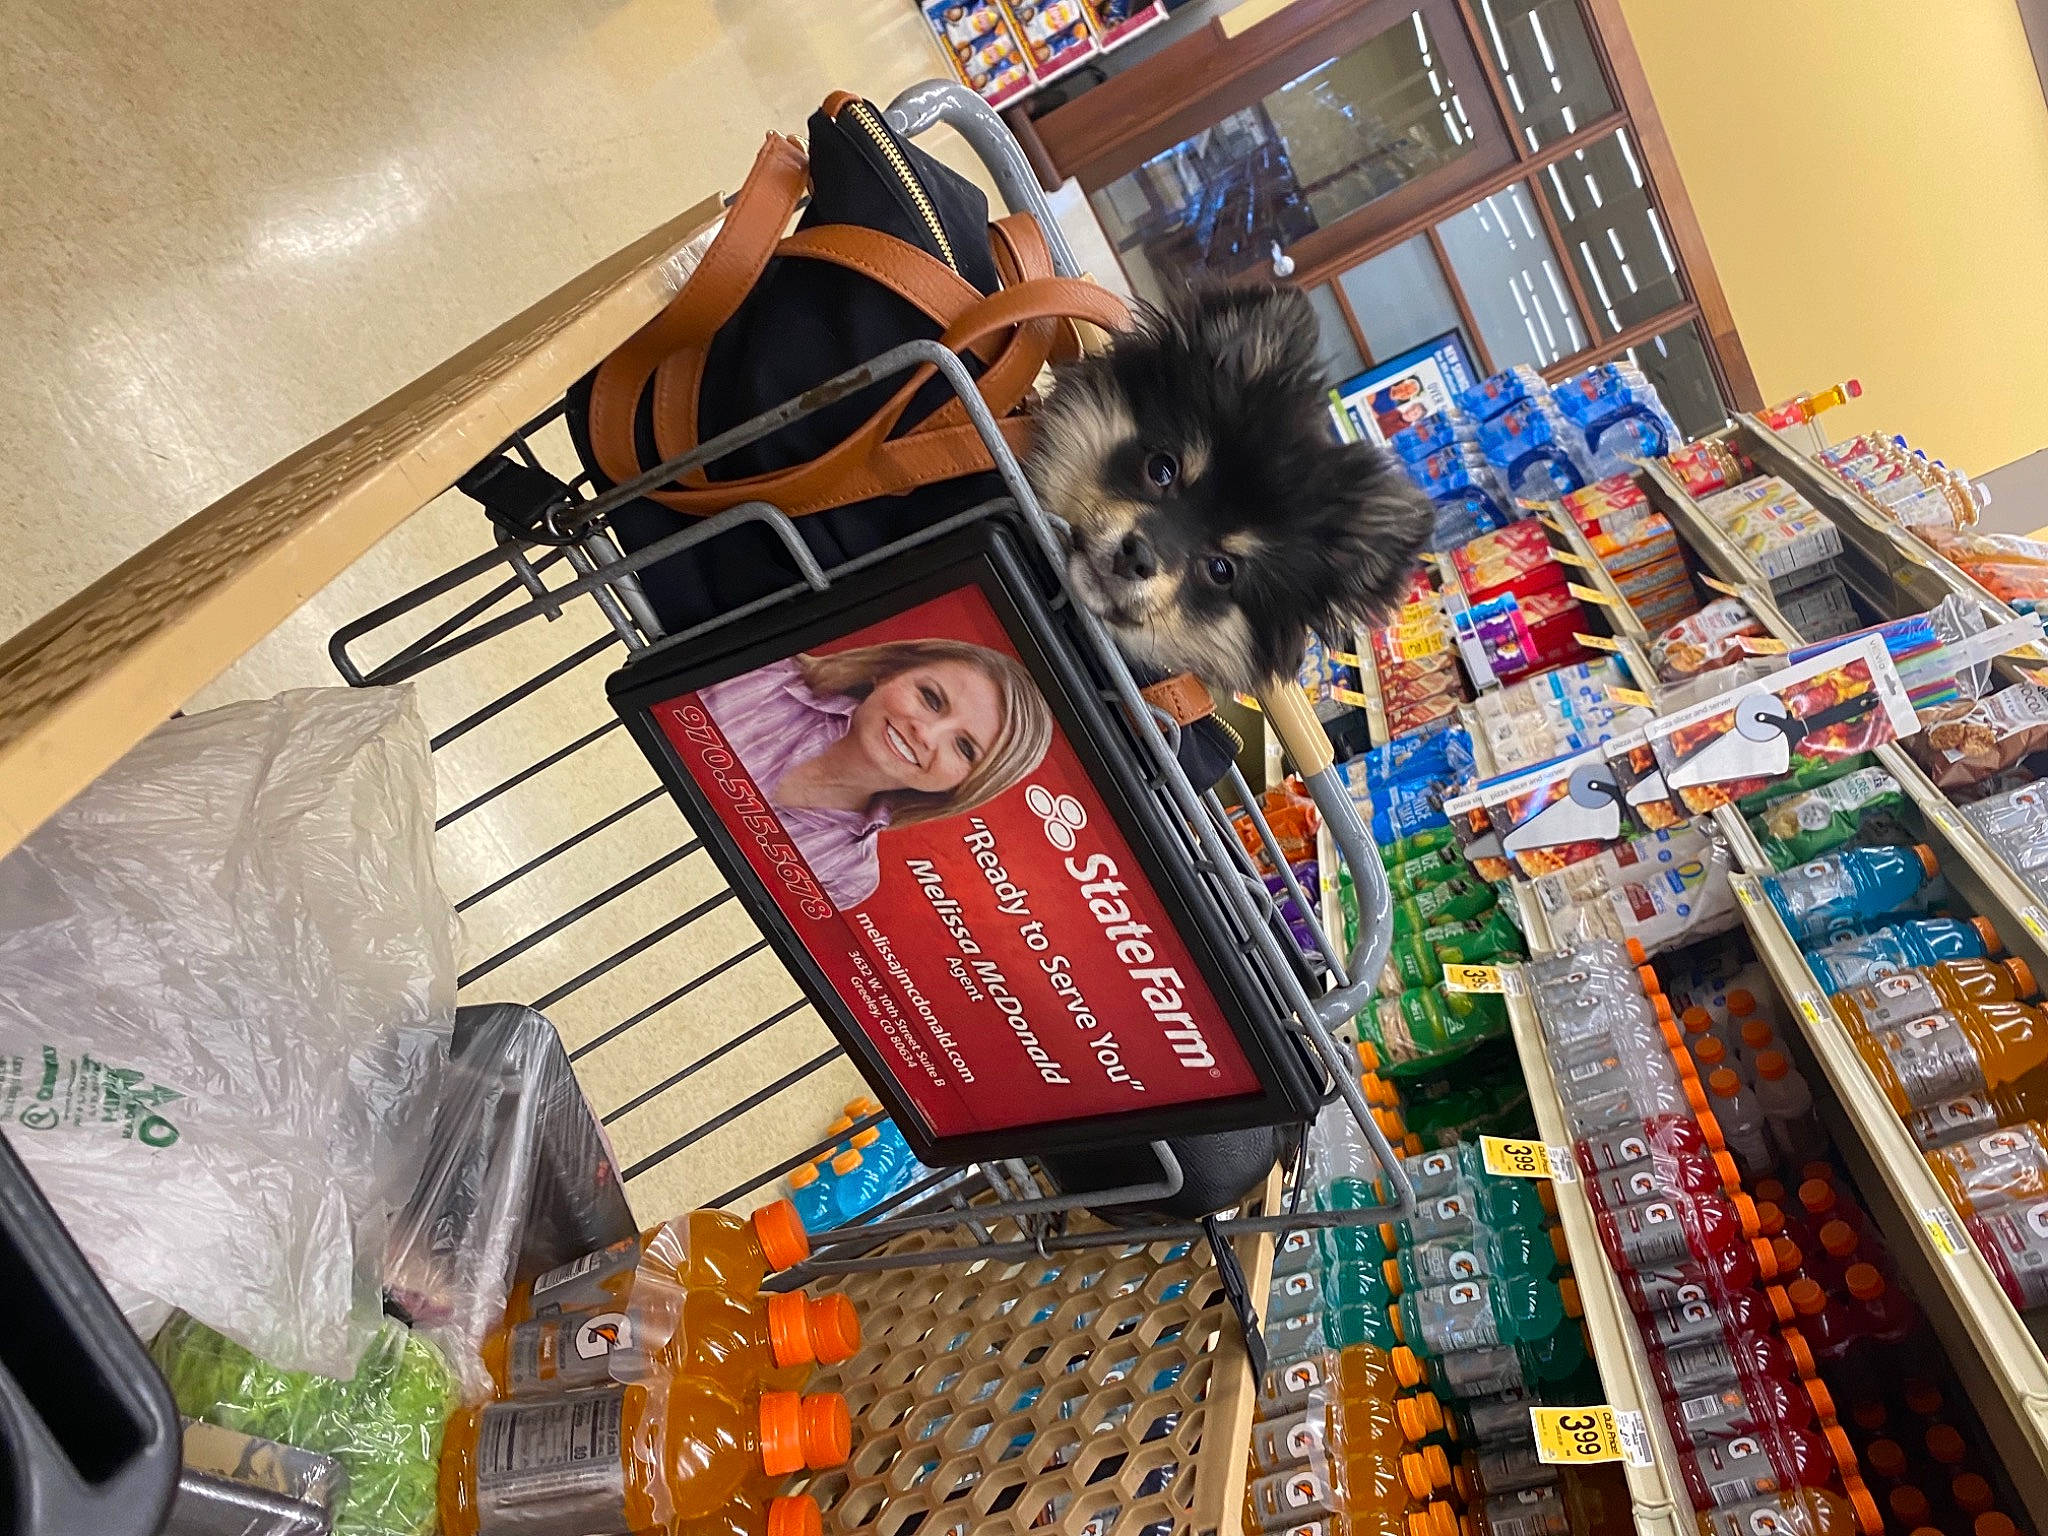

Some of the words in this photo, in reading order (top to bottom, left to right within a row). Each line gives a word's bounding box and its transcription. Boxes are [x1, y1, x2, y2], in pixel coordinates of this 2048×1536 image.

[672, 705, 833, 920] 970.515.5678
[855, 912, 975, 1083] melissajmcdonald.com
[906, 860, 981, 954] Melissa
[970, 960, 1071, 1084] McDonald
[945, 957, 984, 1002] Agent
[1020, 920, 1049, 951] to
[1039, 955, 1097, 1030] Serve
[848, 950, 873, 977] 3632
[867, 977, 883, 993] W.
[878, 993, 899, 1018] 10th
[894, 1018, 921, 1051] Street
[915, 1051, 938, 1078] Suite
[933, 1078, 946, 1087] B
[850, 976, 882, 1018] Greeley,
[879, 1019, 896, 1035] CO
[890, 1035, 918, 1068] 80634
[1503, 1144, 1535, 1171] 399
[575, 1312, 634, 1358] G
[1558, 1415, 1602, 1455] 399
[1602, 1412, 1613, 1431] Club
[1607, 1431, 1620, 1455] Price!
